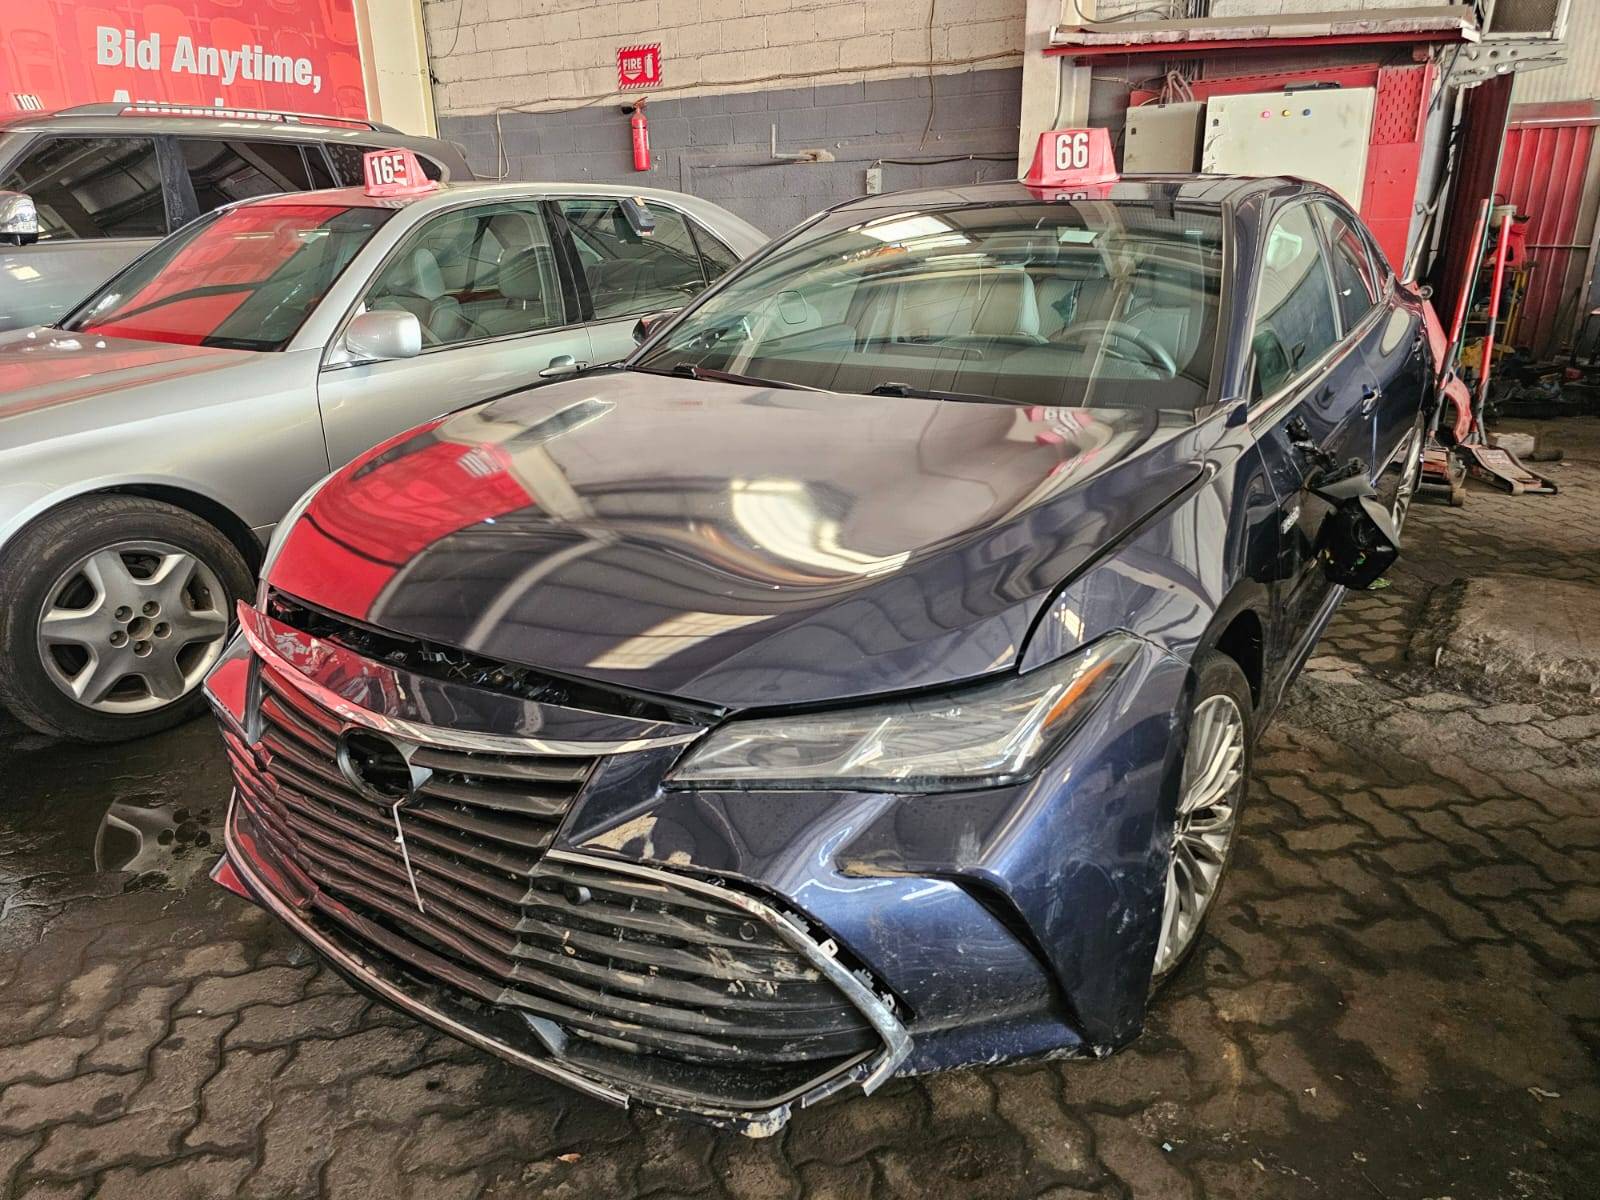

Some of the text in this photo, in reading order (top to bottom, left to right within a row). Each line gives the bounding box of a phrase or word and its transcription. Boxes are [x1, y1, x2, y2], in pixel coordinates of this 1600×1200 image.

[97, 26, 322, 94] Bid Anytime,
[622, 57, 642, 70] FIRE
[1056, 132, 1088, 169] 66
[372, 154, 407, 185] 165
